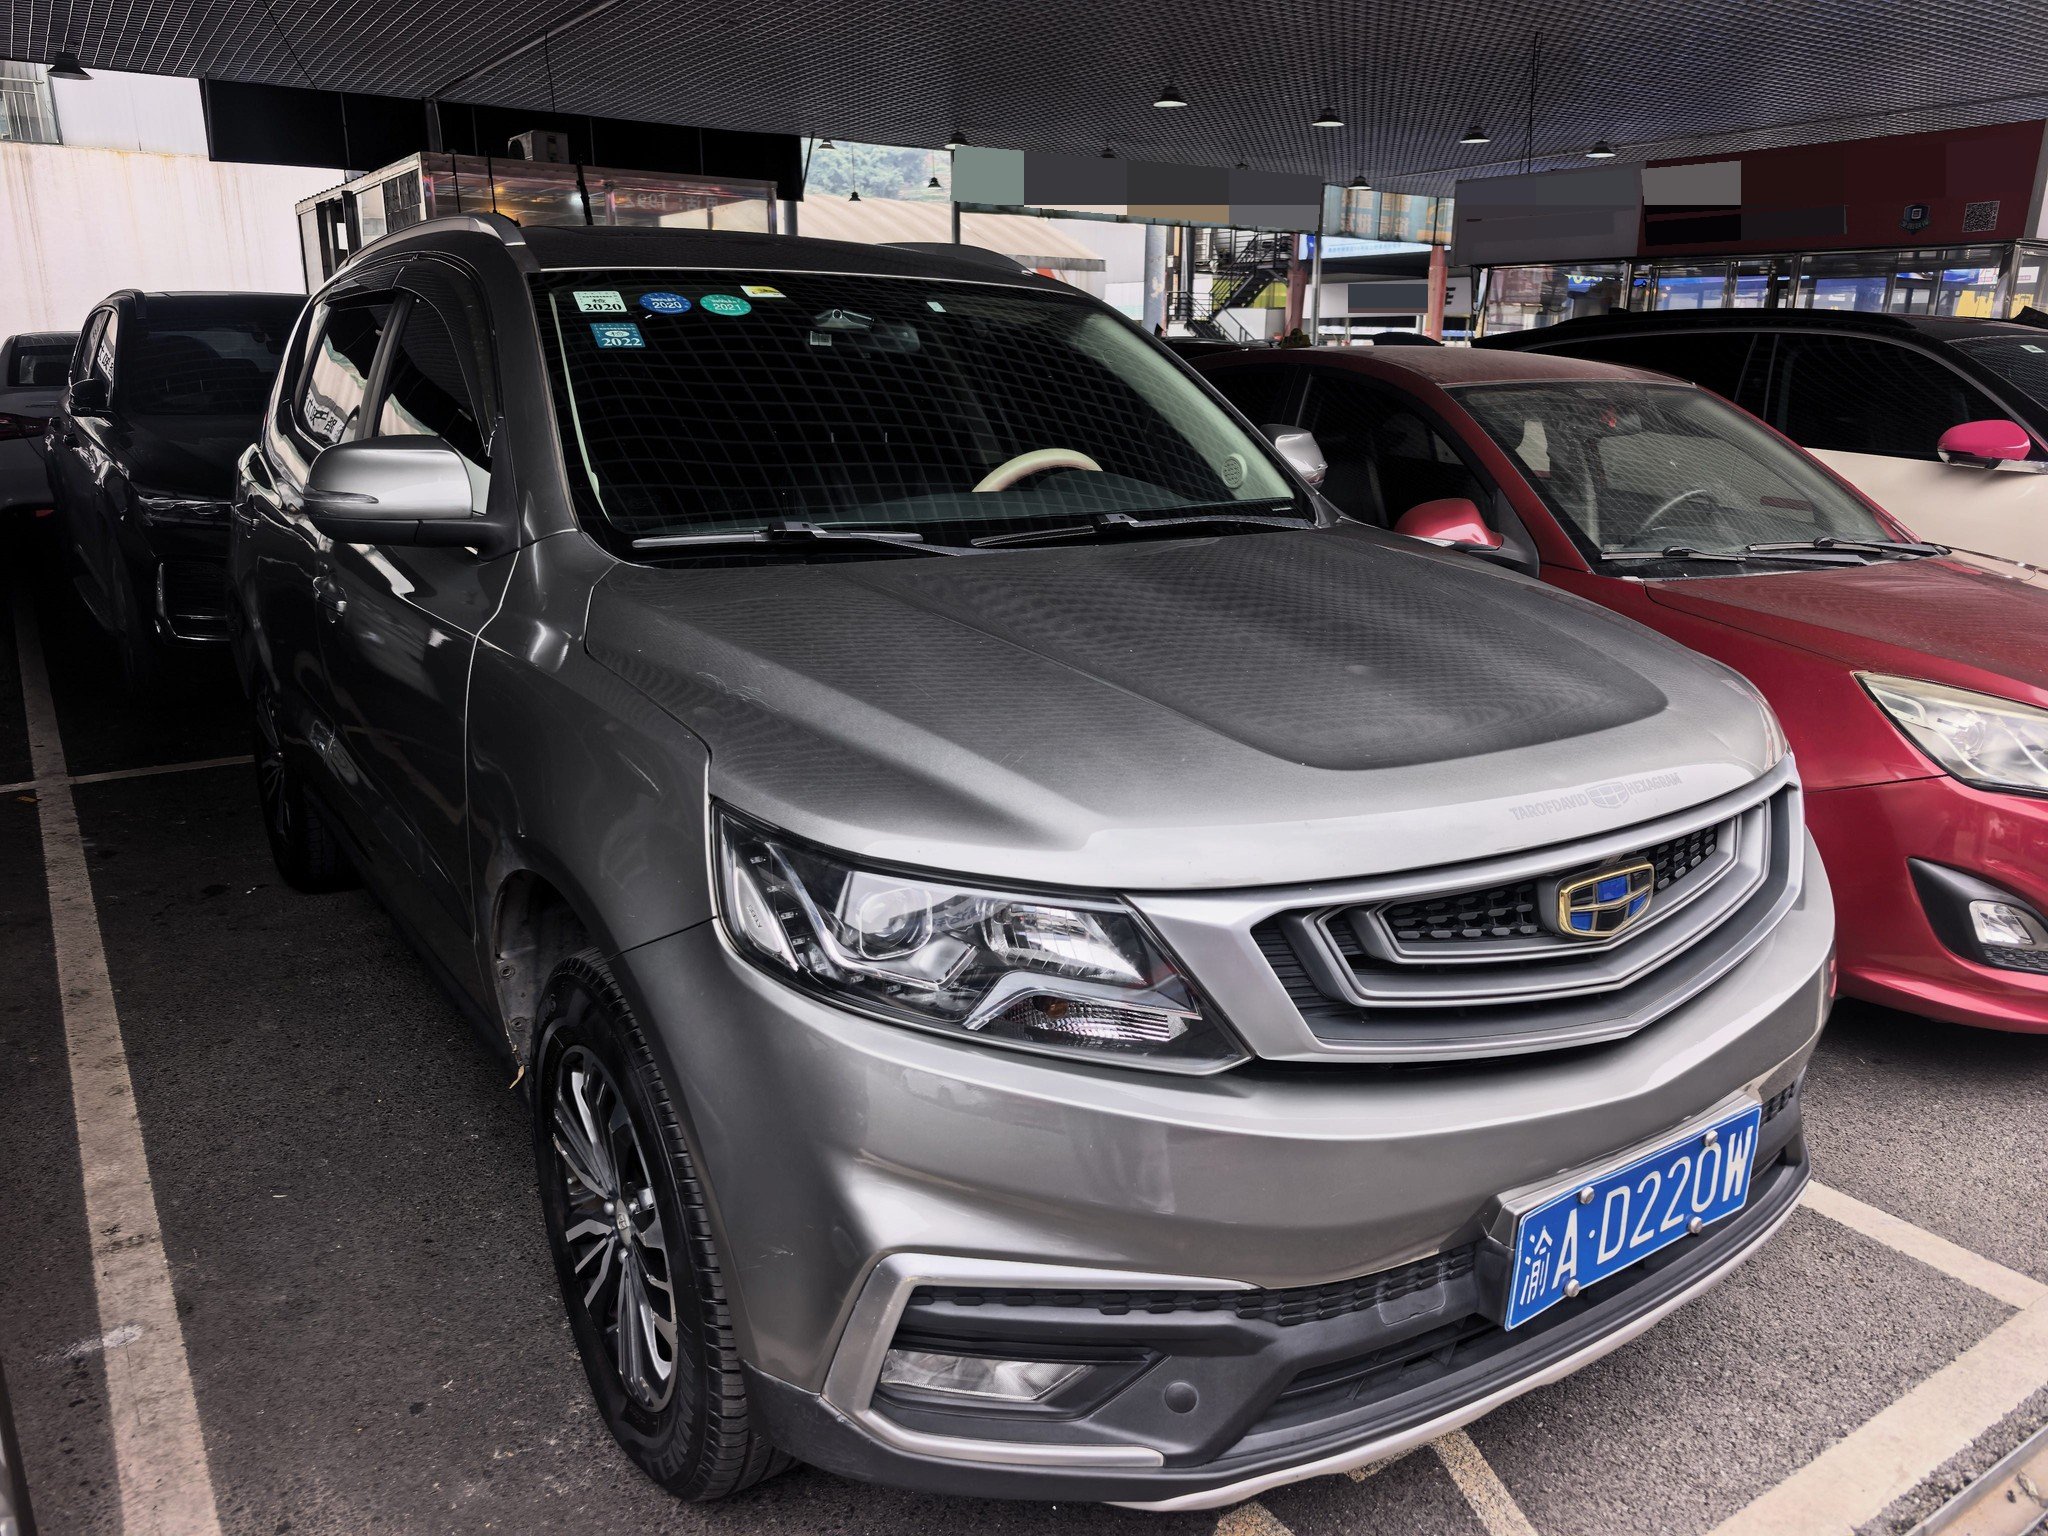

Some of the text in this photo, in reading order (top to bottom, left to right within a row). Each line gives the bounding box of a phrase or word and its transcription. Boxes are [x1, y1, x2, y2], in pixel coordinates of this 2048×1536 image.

[583, 303, 622, 311] 2020
[652, 301, 682, 310] 2020
[713, 303, 743, 312] 2021
[602, 337, 642, 347] 2022
[1624, 771, 1683, 796] HEXAGRAM
